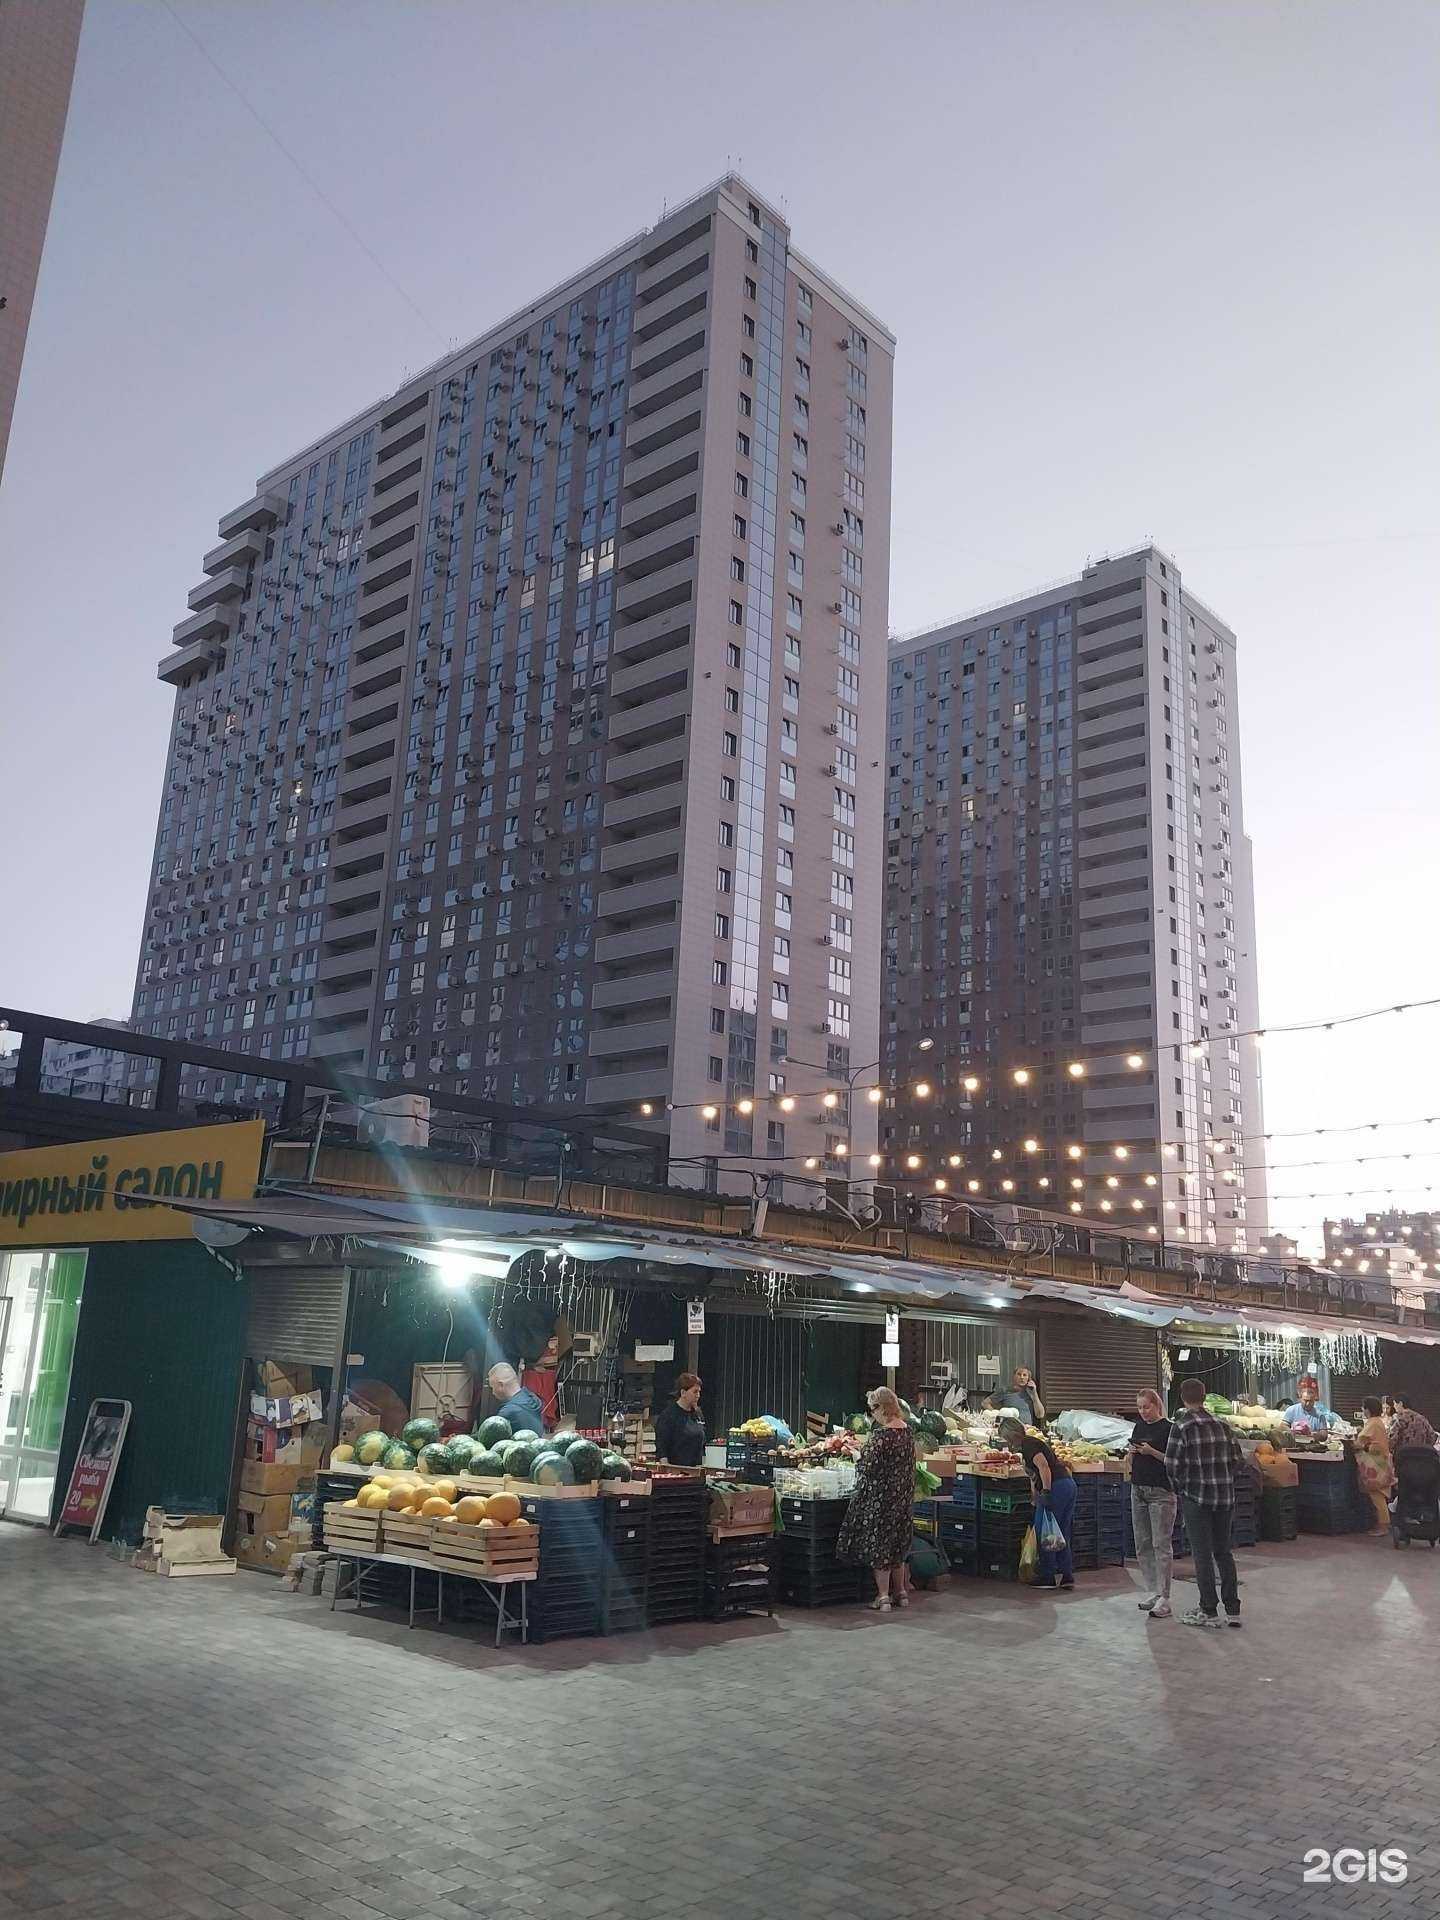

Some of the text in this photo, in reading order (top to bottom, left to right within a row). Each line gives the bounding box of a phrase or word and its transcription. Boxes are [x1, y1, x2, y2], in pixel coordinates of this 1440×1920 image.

[0, 1155, 224, 1228] ирный салон
[70, 1490, 82, 1505] 20
